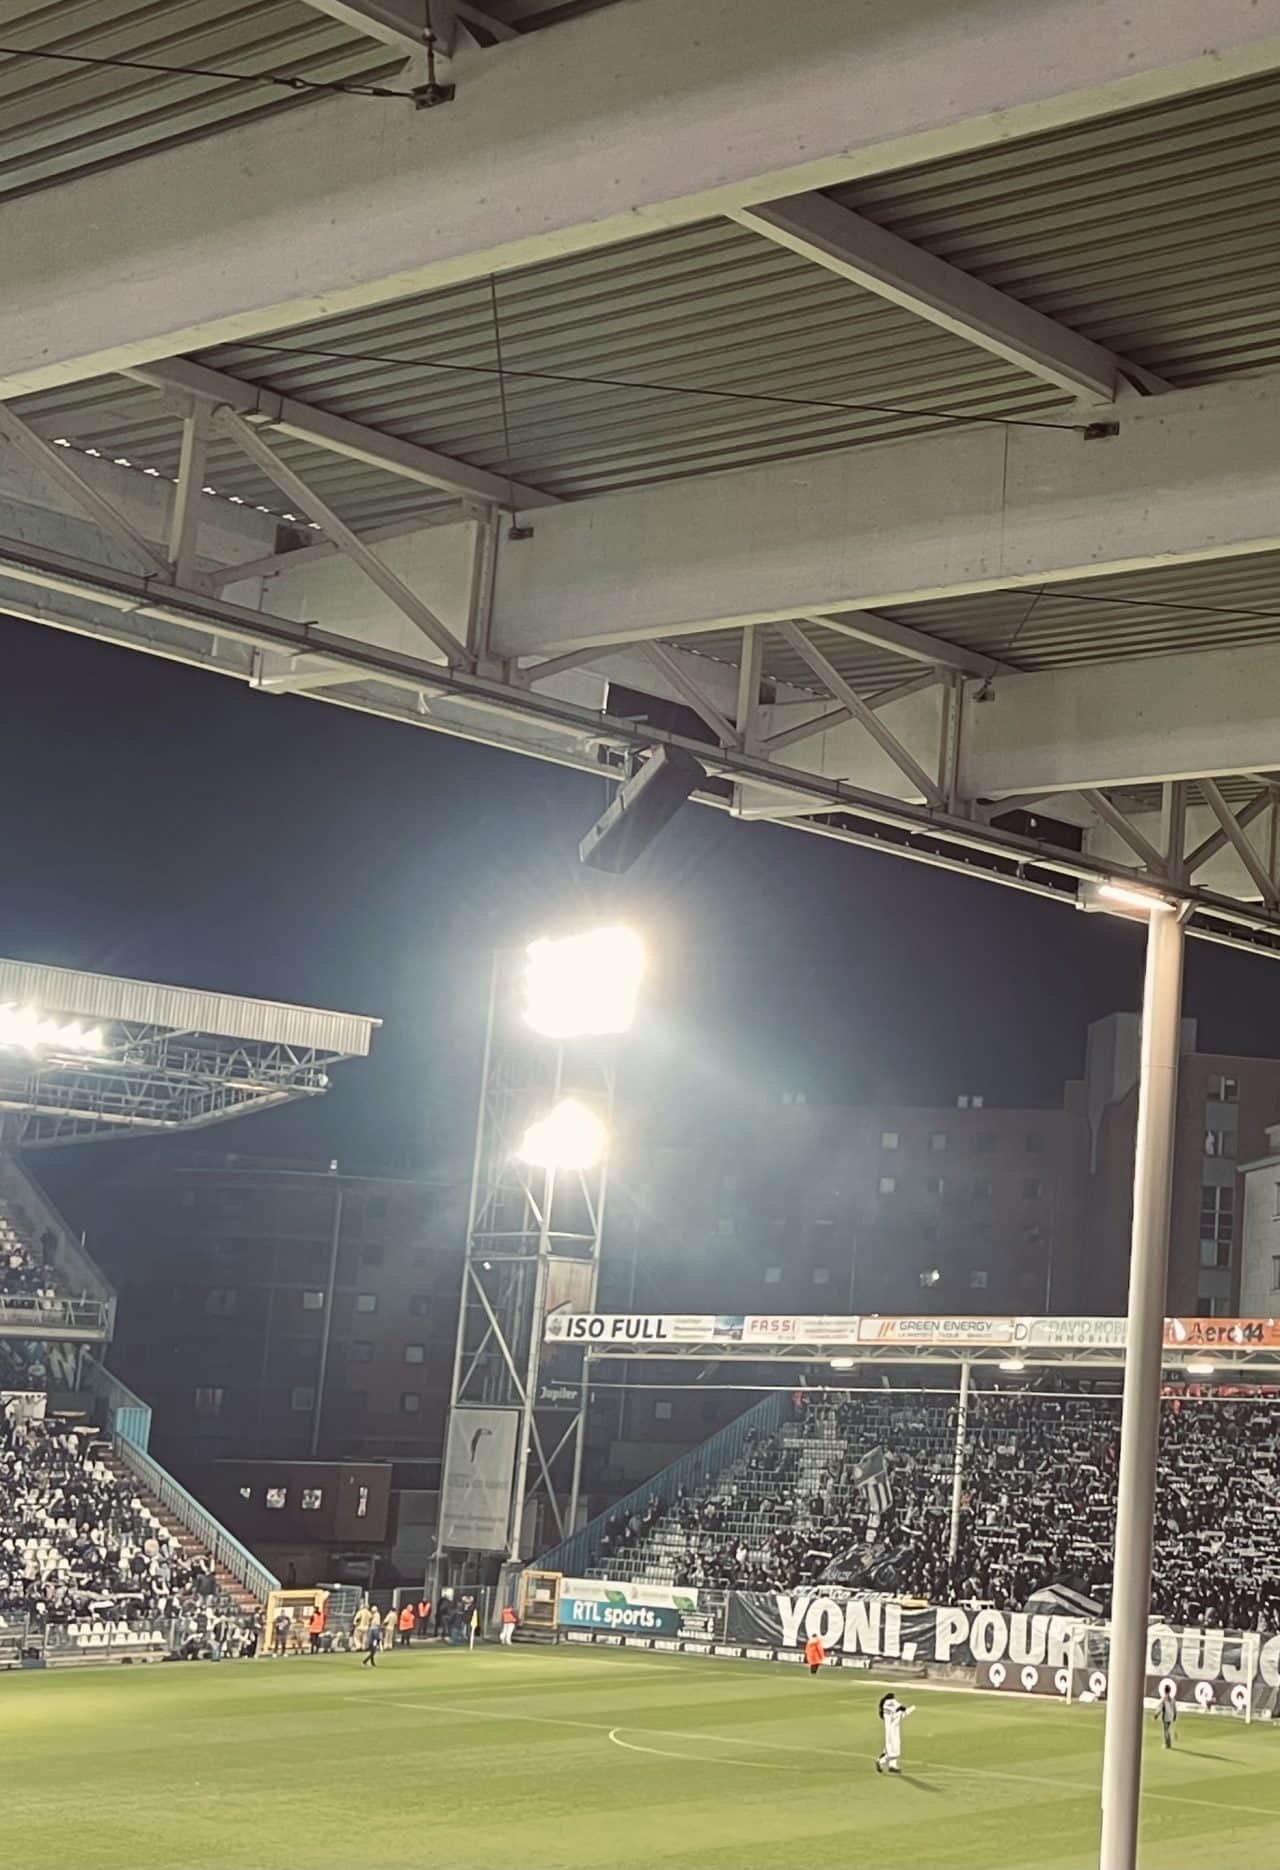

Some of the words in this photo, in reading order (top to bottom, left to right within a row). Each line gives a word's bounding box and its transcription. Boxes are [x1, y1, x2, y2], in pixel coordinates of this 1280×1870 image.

[566, 1317, 605, 1338] ISO
[611, 1318, 667, 1339] FULL
[750, 1319, 796, 1332] FASSI
[899, 1320, 939, 1330] GREEN
[943, 1320, 993, 1332] ENERGY
[572, 1601, 601, 1621] RTL
[776, 1594, 918, 1661] YONI,
[935, 1607, 1087, 1668] POUR
